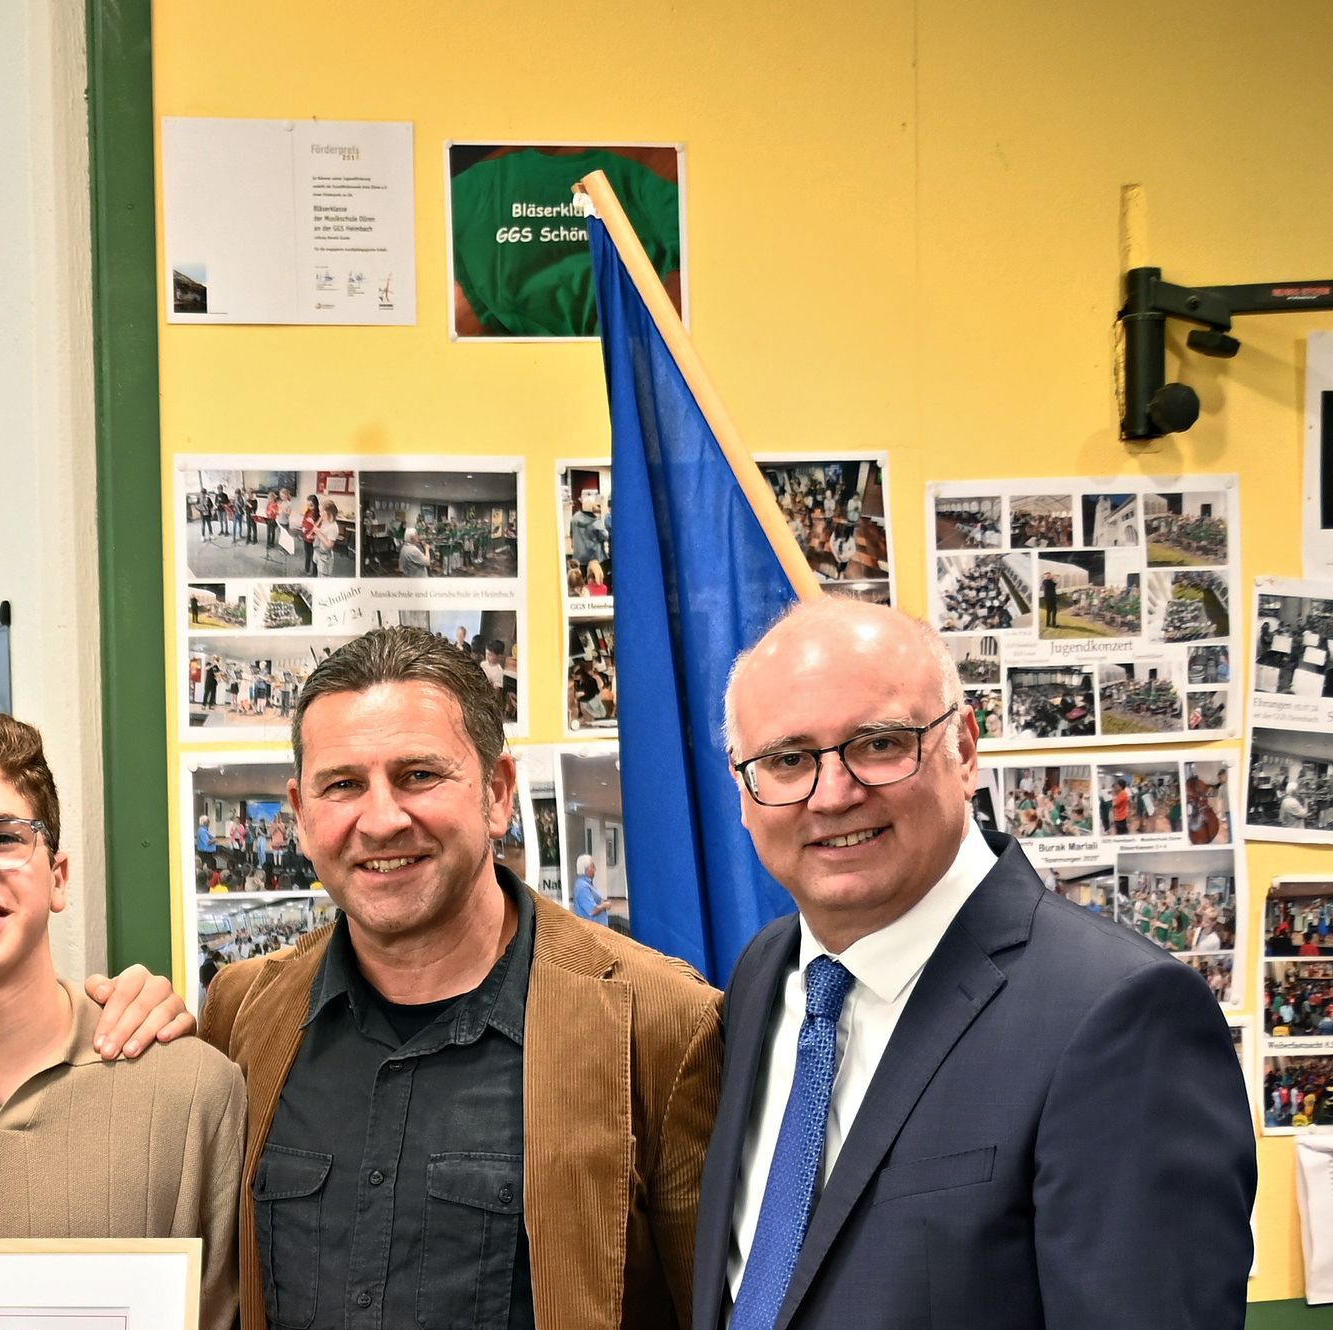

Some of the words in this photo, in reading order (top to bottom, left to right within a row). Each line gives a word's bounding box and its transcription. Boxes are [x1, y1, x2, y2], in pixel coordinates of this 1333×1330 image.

[512, 202, 584, 218] Bläserkla
[496, 227, 533, 243] GGS
[539, 225, 588, 242] Schön
[318, 585, 363, 608] Schuljahr
[1050, 640, 1133, 657] Jugendkonzert
[1038, 843, 1066, 853] Burak
